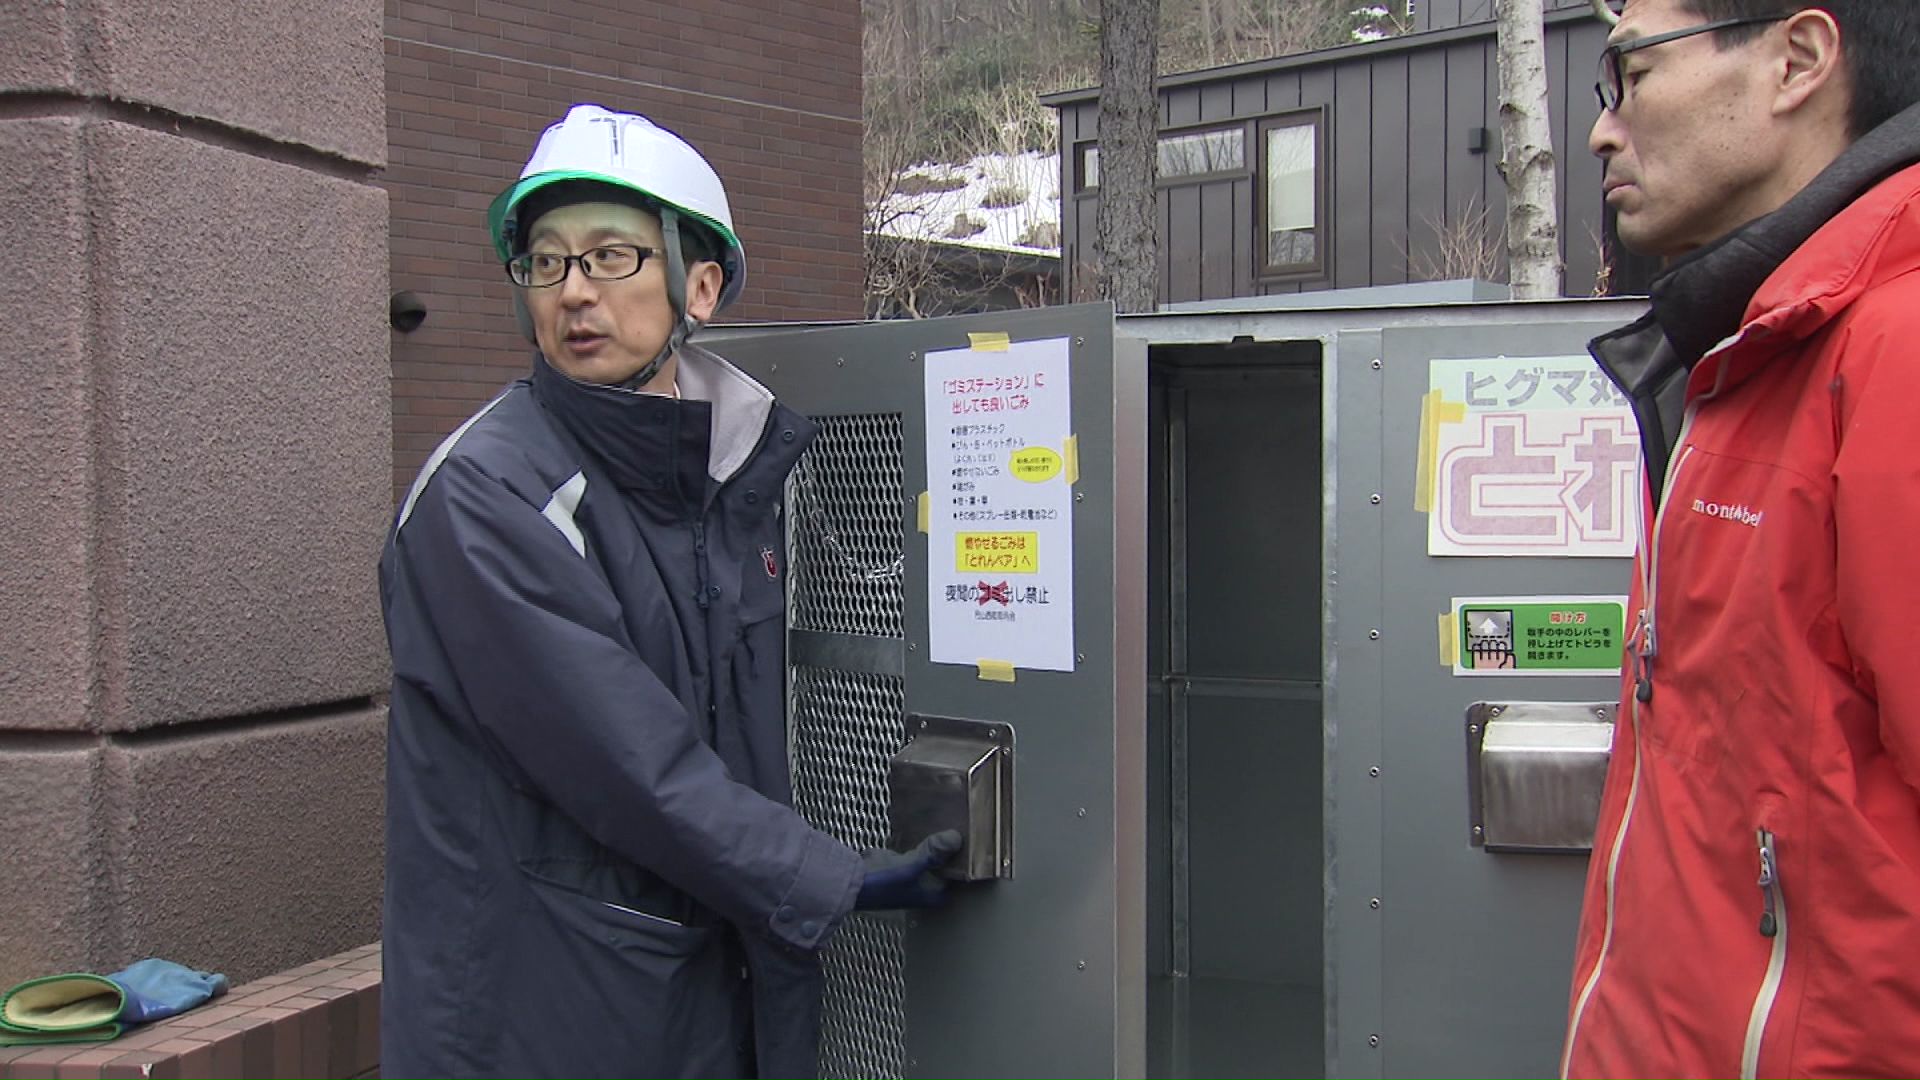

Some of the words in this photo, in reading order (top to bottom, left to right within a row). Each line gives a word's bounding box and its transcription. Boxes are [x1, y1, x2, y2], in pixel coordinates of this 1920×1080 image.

[943, 373, 1044, 394] 「ゴミステーション」に
[952, 394, 1030, 414] 出しても良いごみ
[965, 536, 1026, 550] 燃やせるごみは
[1550, 612, 1587, 624] 開け方
[1527, 628, 1611, 637] 取手の中のレバーを
[1527, 639, 1611, 648] 押し上げてトビラを
[1527, 651, 1569, 660] 開きます。
